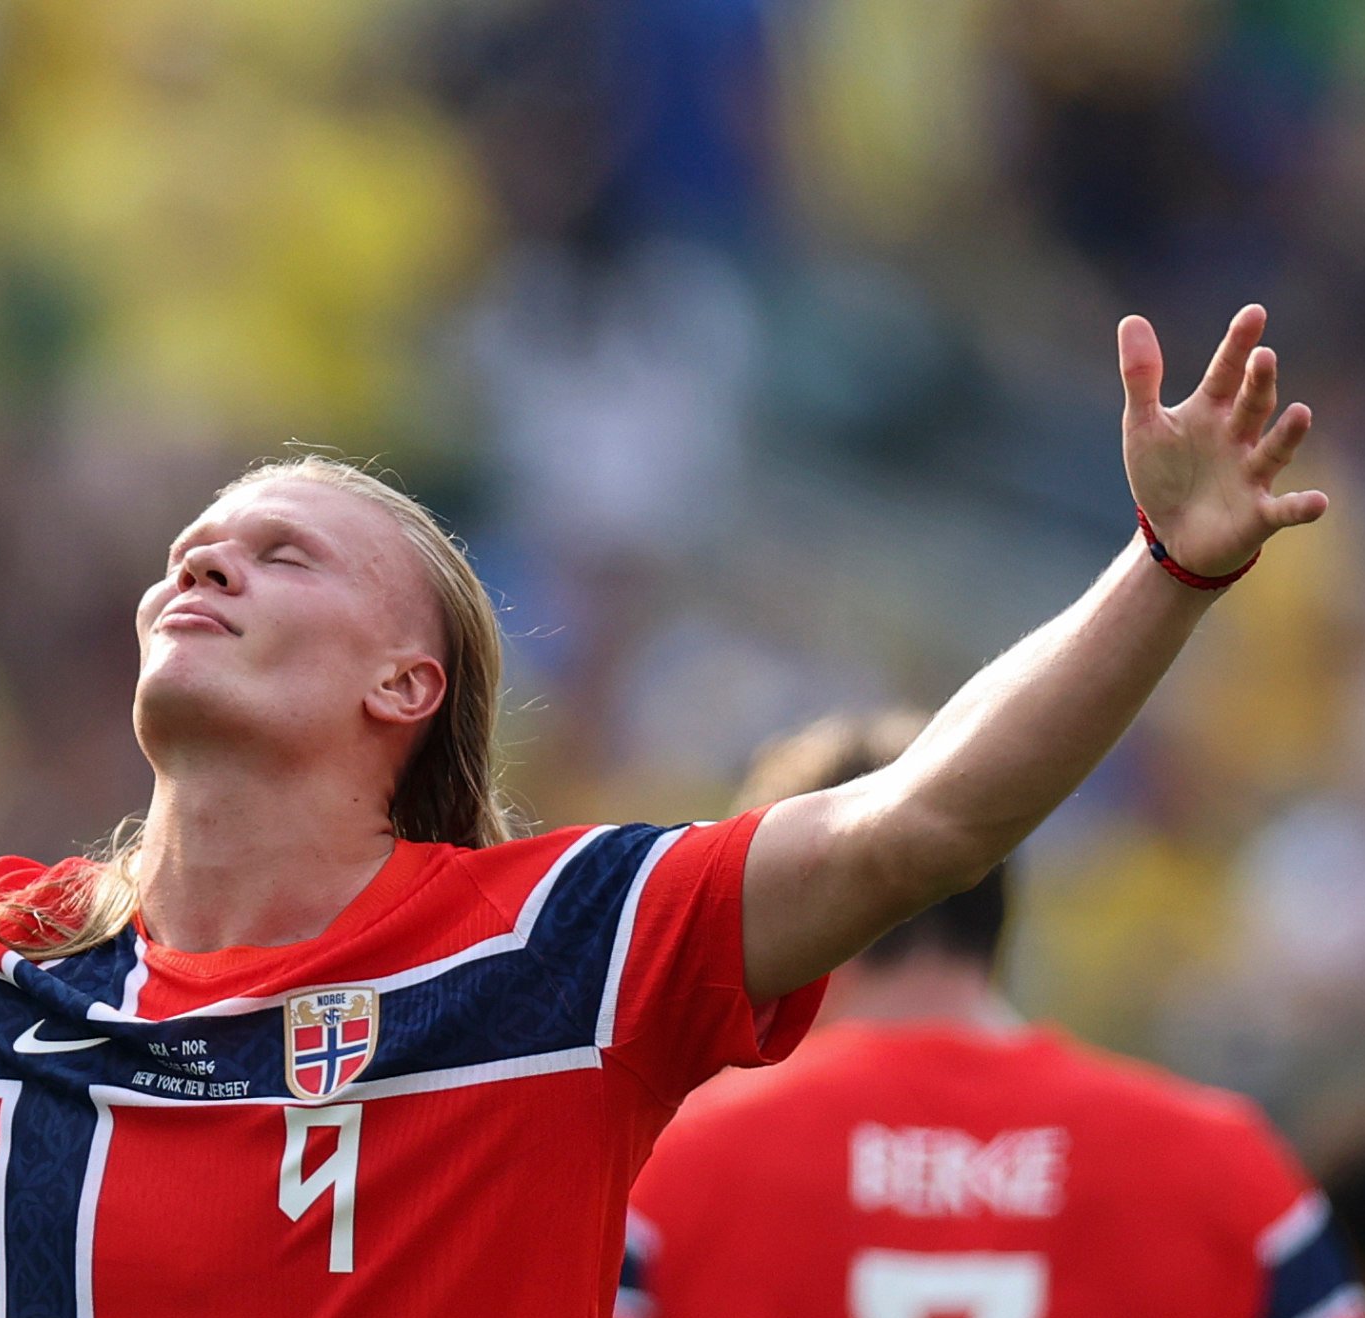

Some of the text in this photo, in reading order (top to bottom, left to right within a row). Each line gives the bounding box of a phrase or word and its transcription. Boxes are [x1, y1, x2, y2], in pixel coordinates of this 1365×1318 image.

[317, 993, 346, 1006] NORGE
[182, 1040, 207, 1055] NOR
[132, 1071, 250, 1097] NEW YORK NEW JERSEY
[278, 1103, 363, 1273] 9
